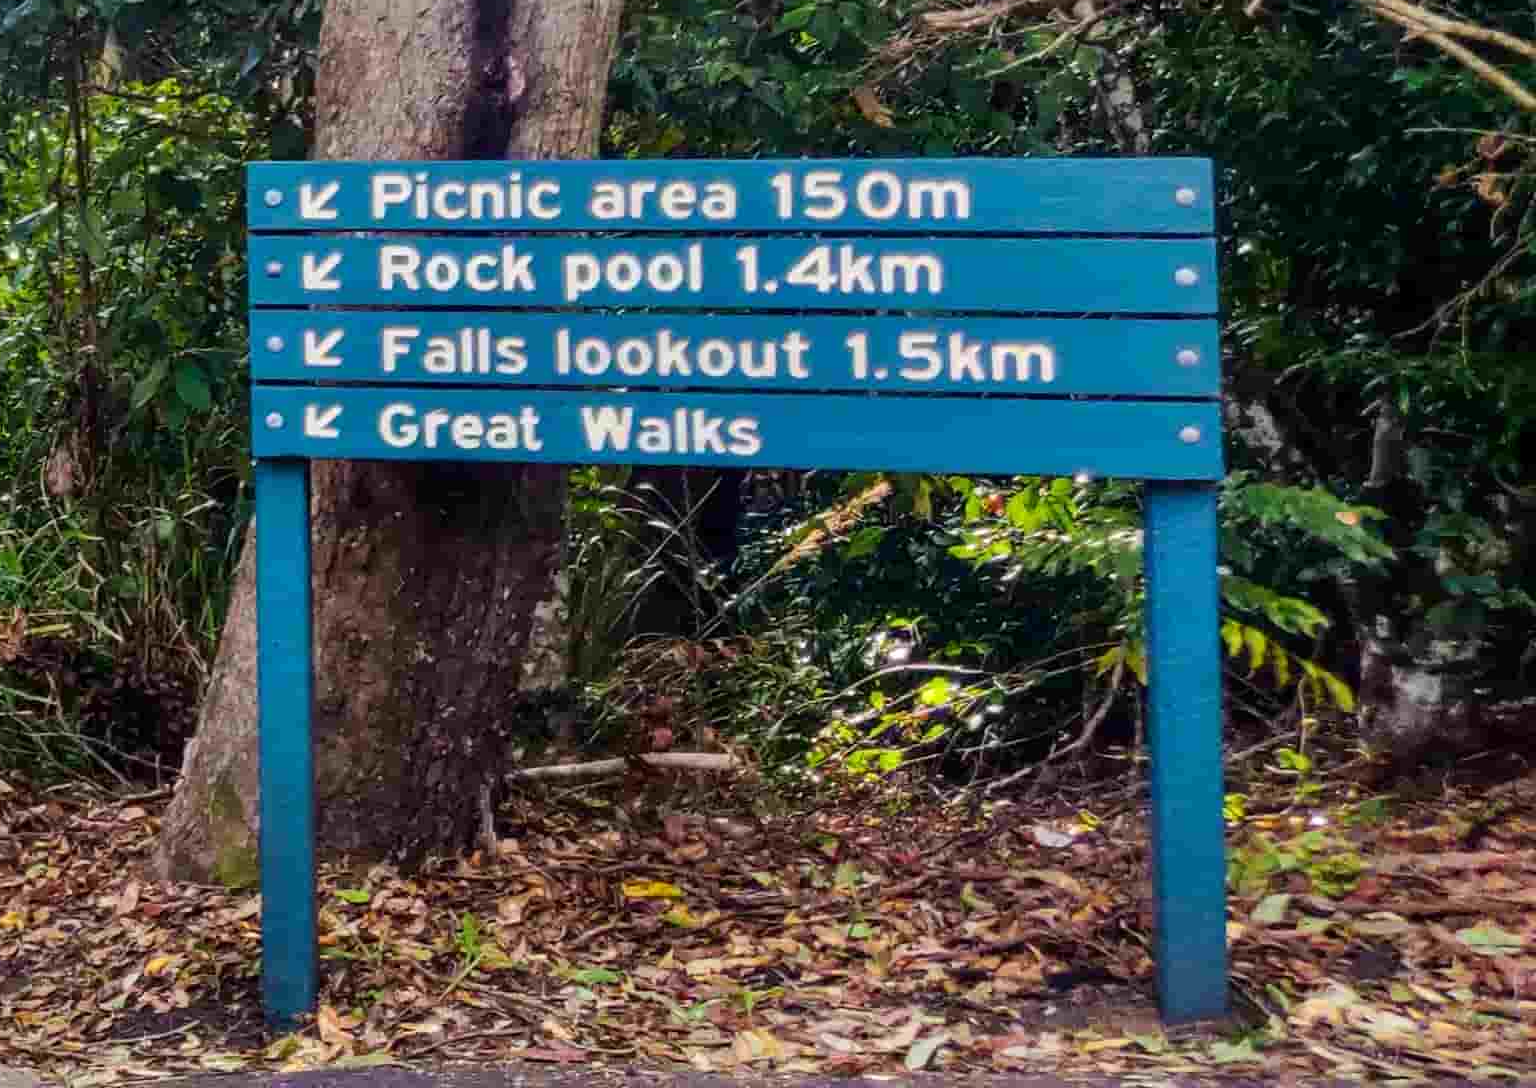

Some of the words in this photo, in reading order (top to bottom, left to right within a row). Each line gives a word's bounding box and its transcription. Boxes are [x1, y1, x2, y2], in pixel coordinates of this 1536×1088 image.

[371, 171, 561, 220] Picnic
[588, 180, 737, 220] area
[771, 170, 971, 220] 150m
[379, 244, 535, 292] Rock
[564, 243, 703, 302] pool
[735, 244, 943, 294] 1.4km
[382, 327, 528, 374] Falls
[556, 328, 810, 379] lookout
[846, 331, 1055, 383] 1.5km
[378, 403, 543, 451] Great
[581, 406, 761, 456] Walks
